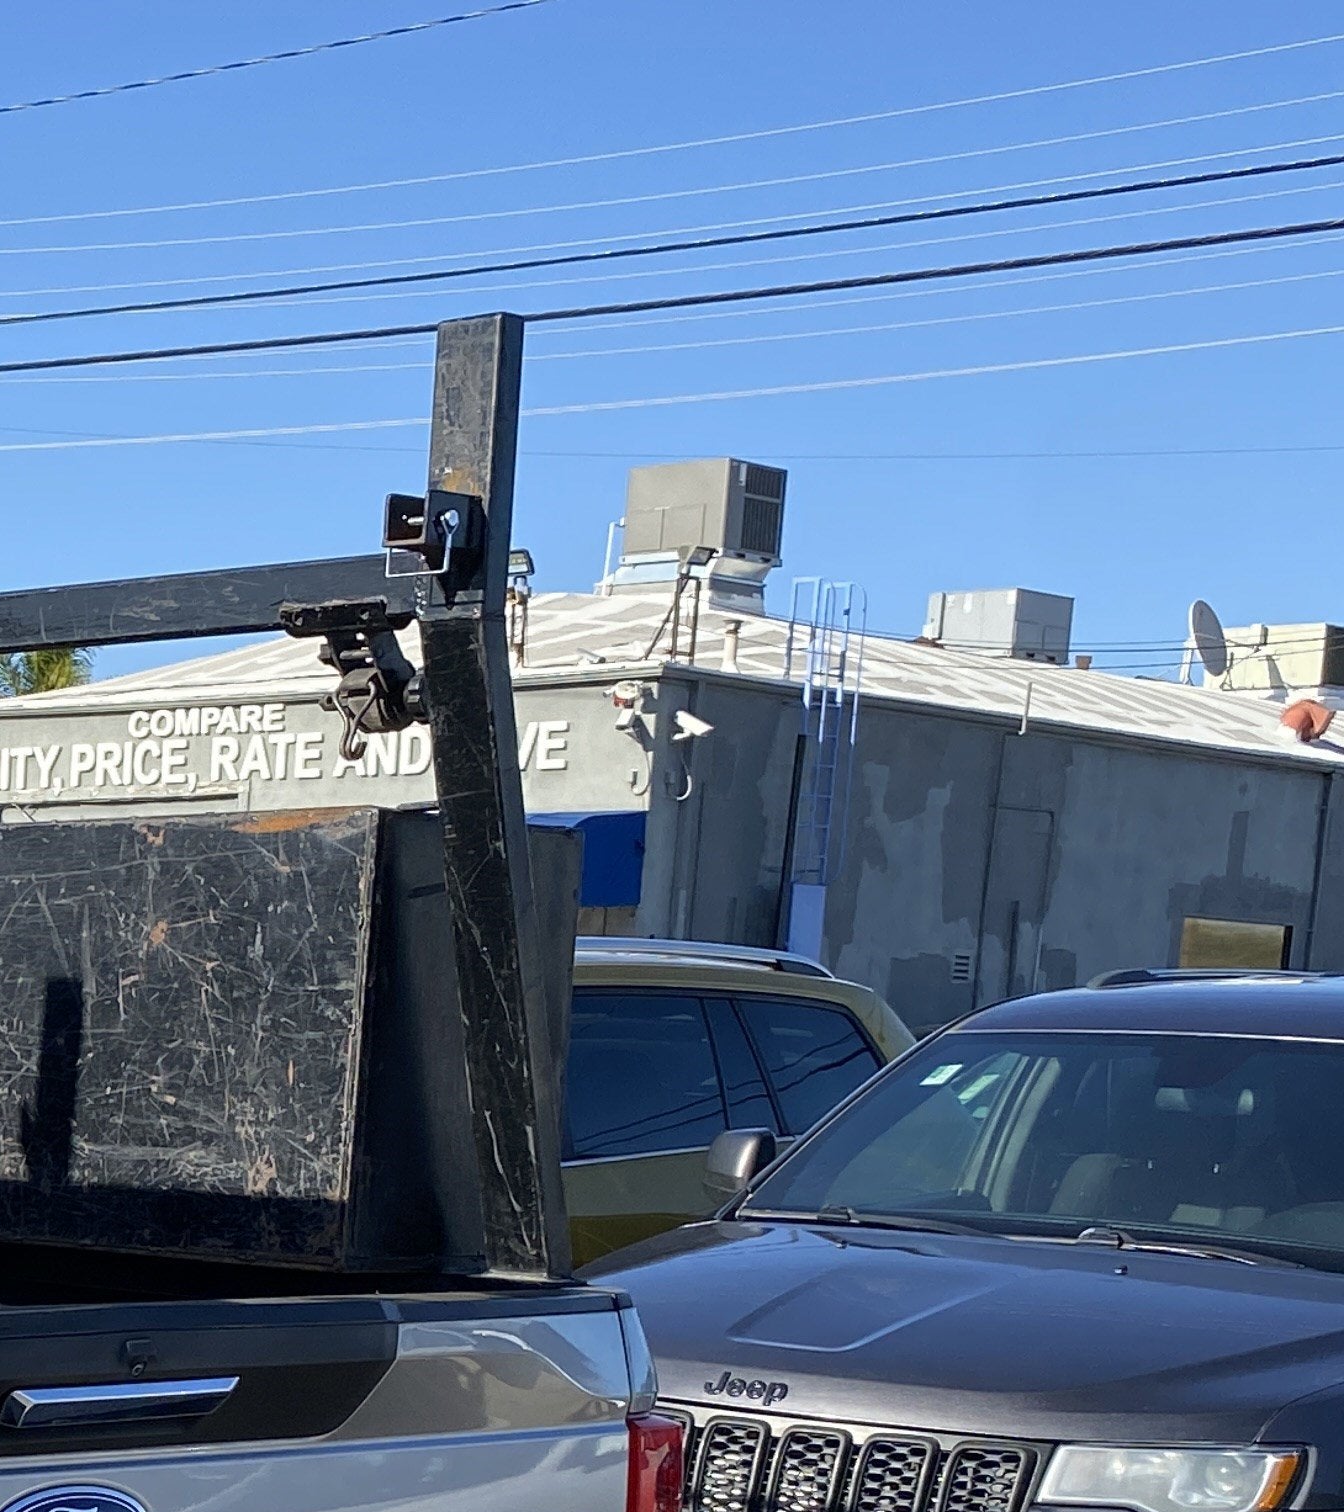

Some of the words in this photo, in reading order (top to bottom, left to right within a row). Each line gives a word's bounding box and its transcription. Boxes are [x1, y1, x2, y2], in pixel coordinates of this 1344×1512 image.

[127, 703, 286, 739] COMPARE
[69, 738, 198, 793] PRICE,
[210, 732, 324, 783] RATE
[332, 729, 434, 778] AND
[703, 1370, 789, 1407] Jeep
